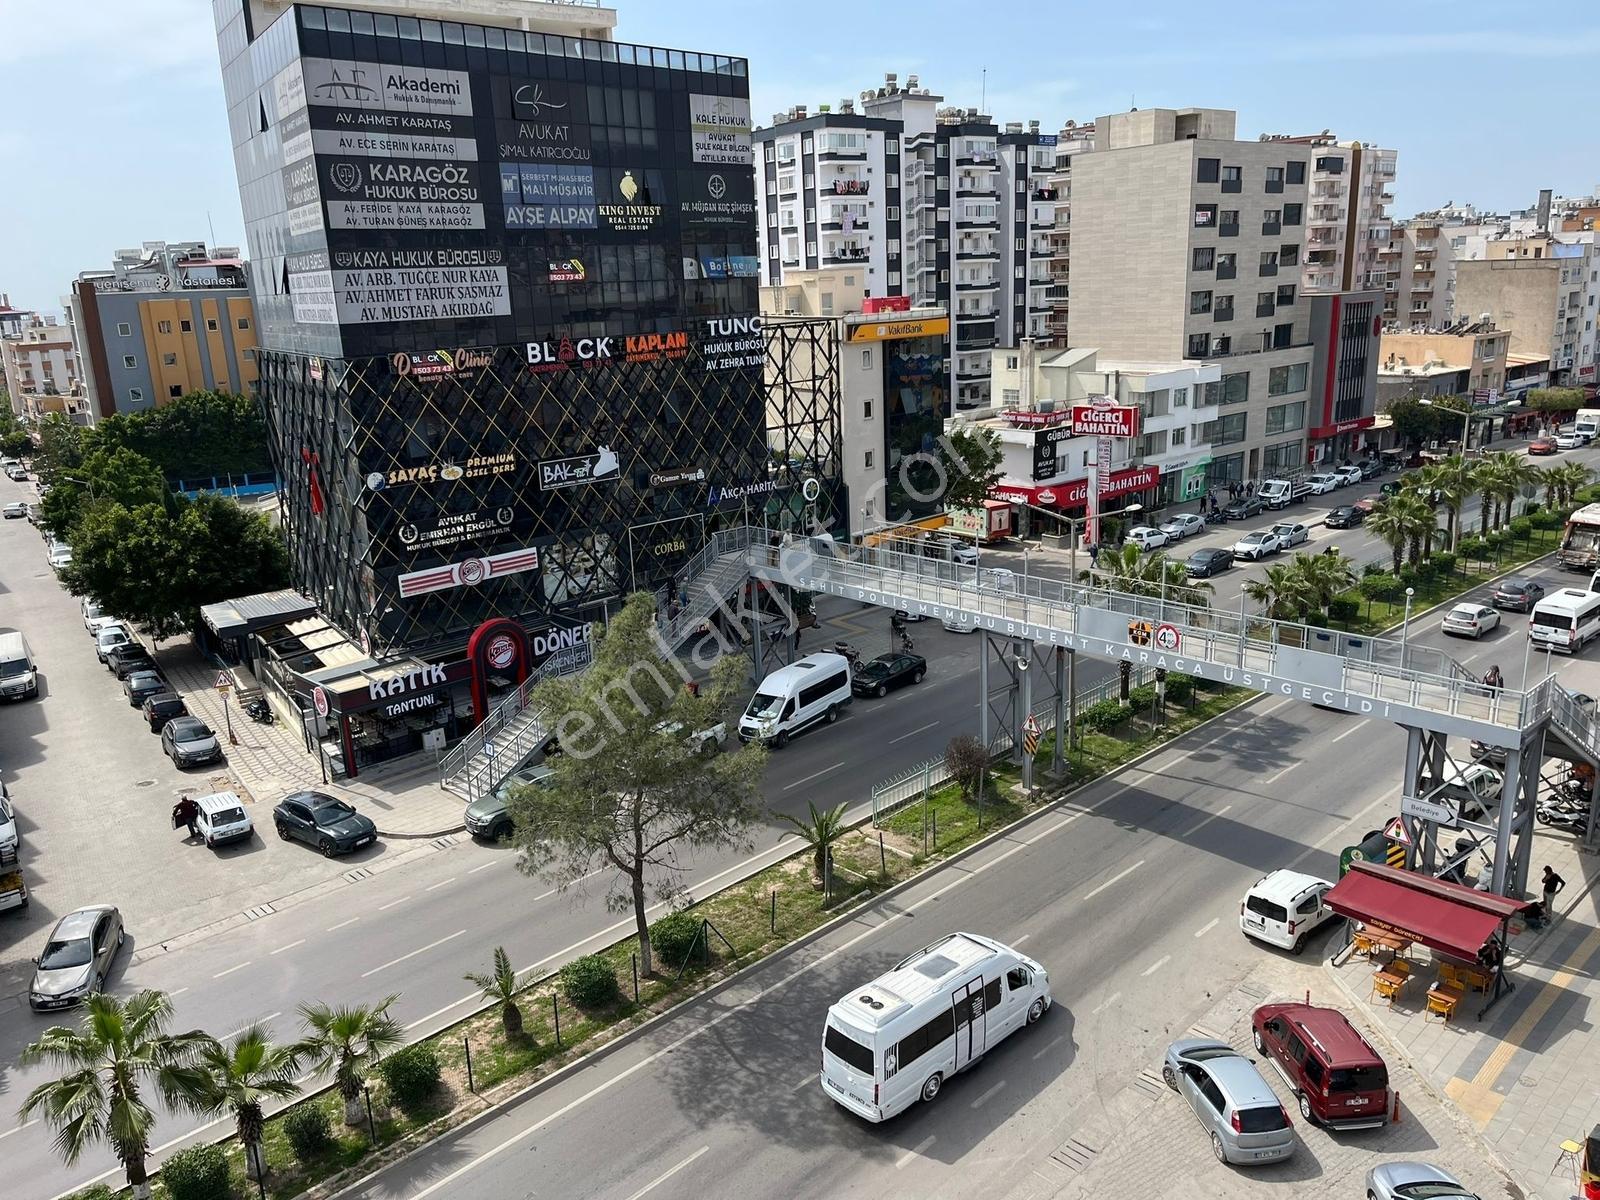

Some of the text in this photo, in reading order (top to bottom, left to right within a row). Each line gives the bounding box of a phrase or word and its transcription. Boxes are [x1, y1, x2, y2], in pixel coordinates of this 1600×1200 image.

[386, 75, 460, 95] Akademi
[393, 93, 414, 103] Hukuk
[335, 112, 452, 132] AV. AHMET KARATAŞ
[695, 113, 746, 127] KALE HUKUK
[518, 123, 569, 141] AVUKAT
[708, 133, 736, 142] AVUKAT
[339, 138, 455, 157] AV. ECE SERİN KARATAŞ
[695, 142, 750, 153] ŞULE KALE BİLGEN
[727, 155, 746, 163] KALE
[369, 163, 470, 184] KARAGÖZ
[521, 173, 549, 182] SERBEST
[365, 184, 478, 201] HUKUK BÜROSU
[522, 182, 593, 197] MALİ MÜŞAVİR
[361, 203, 392, 214] FERİDE
[399, 205, 422, 214] KAYA
[428, 204, 471, 215] KARAGÖZ
[599, 205, 662, 216] KING INVEST
[681, 202, 691, 212] AV.
[363, 217, 395, 226] TURAN
[397, 216, 427, 228] GÜNEŞ
[429, 216, 472, 227] KARAGÖZ
[506, 206, 595, 226] AYŞE ALPAY
[353, 248, 487, 268] KAYA HUKUK BÜROSU
[176, 275, 236, 287] hastanesi
[344, 273, 364, 287] AV.
[366, 272, 396, 286] ARB.
[398, 269, 440, 287] TUĞÇE
[441, 270, 468, 284] NUR
[469, 269, 500, 283] KAYA
[345, 290, 364, 304] AV.
[367, 288, 412, 303] AHMET
[415, 286, 454, 302] FARUK
[360, 300, 494, 321] AV. MUSTAFA AKIRDAĞ
[706, 315, 764, 336] TUNÇ
[625, 331, 687, 352] KAPLAN
[704, 337, 767, 355] HUKUK BÜROSU
[706, 360, 719, 371] AV.
[720, 356, 746, 369] ZEHRA
[1081, 409, 1123, 423] CİĞERCİ
[1074, 422, 1129, 435] BAHATTİN
[388, 465, 438, 484] SAYAÇ
[465, 463, 515, 478] ÖZEL DERS
[1109, 471, 1152, 492] BAHATTİN
[719, 480, 777, 500] AKÇA HARİTA
[437, 512, 478, 527] AVUKAT
[466, 518, 497, 531] ERGÜL
[406, 541, 432, 551] HUKUK
[919, 603, 996, 629] MEMURU
[1105, 643, 1204, 675] KARACA
[1159, 631, 1166, 644] 4
[368, 661, 448, 700] KATIK
[1410, 804, 1440, 817] Belediye
